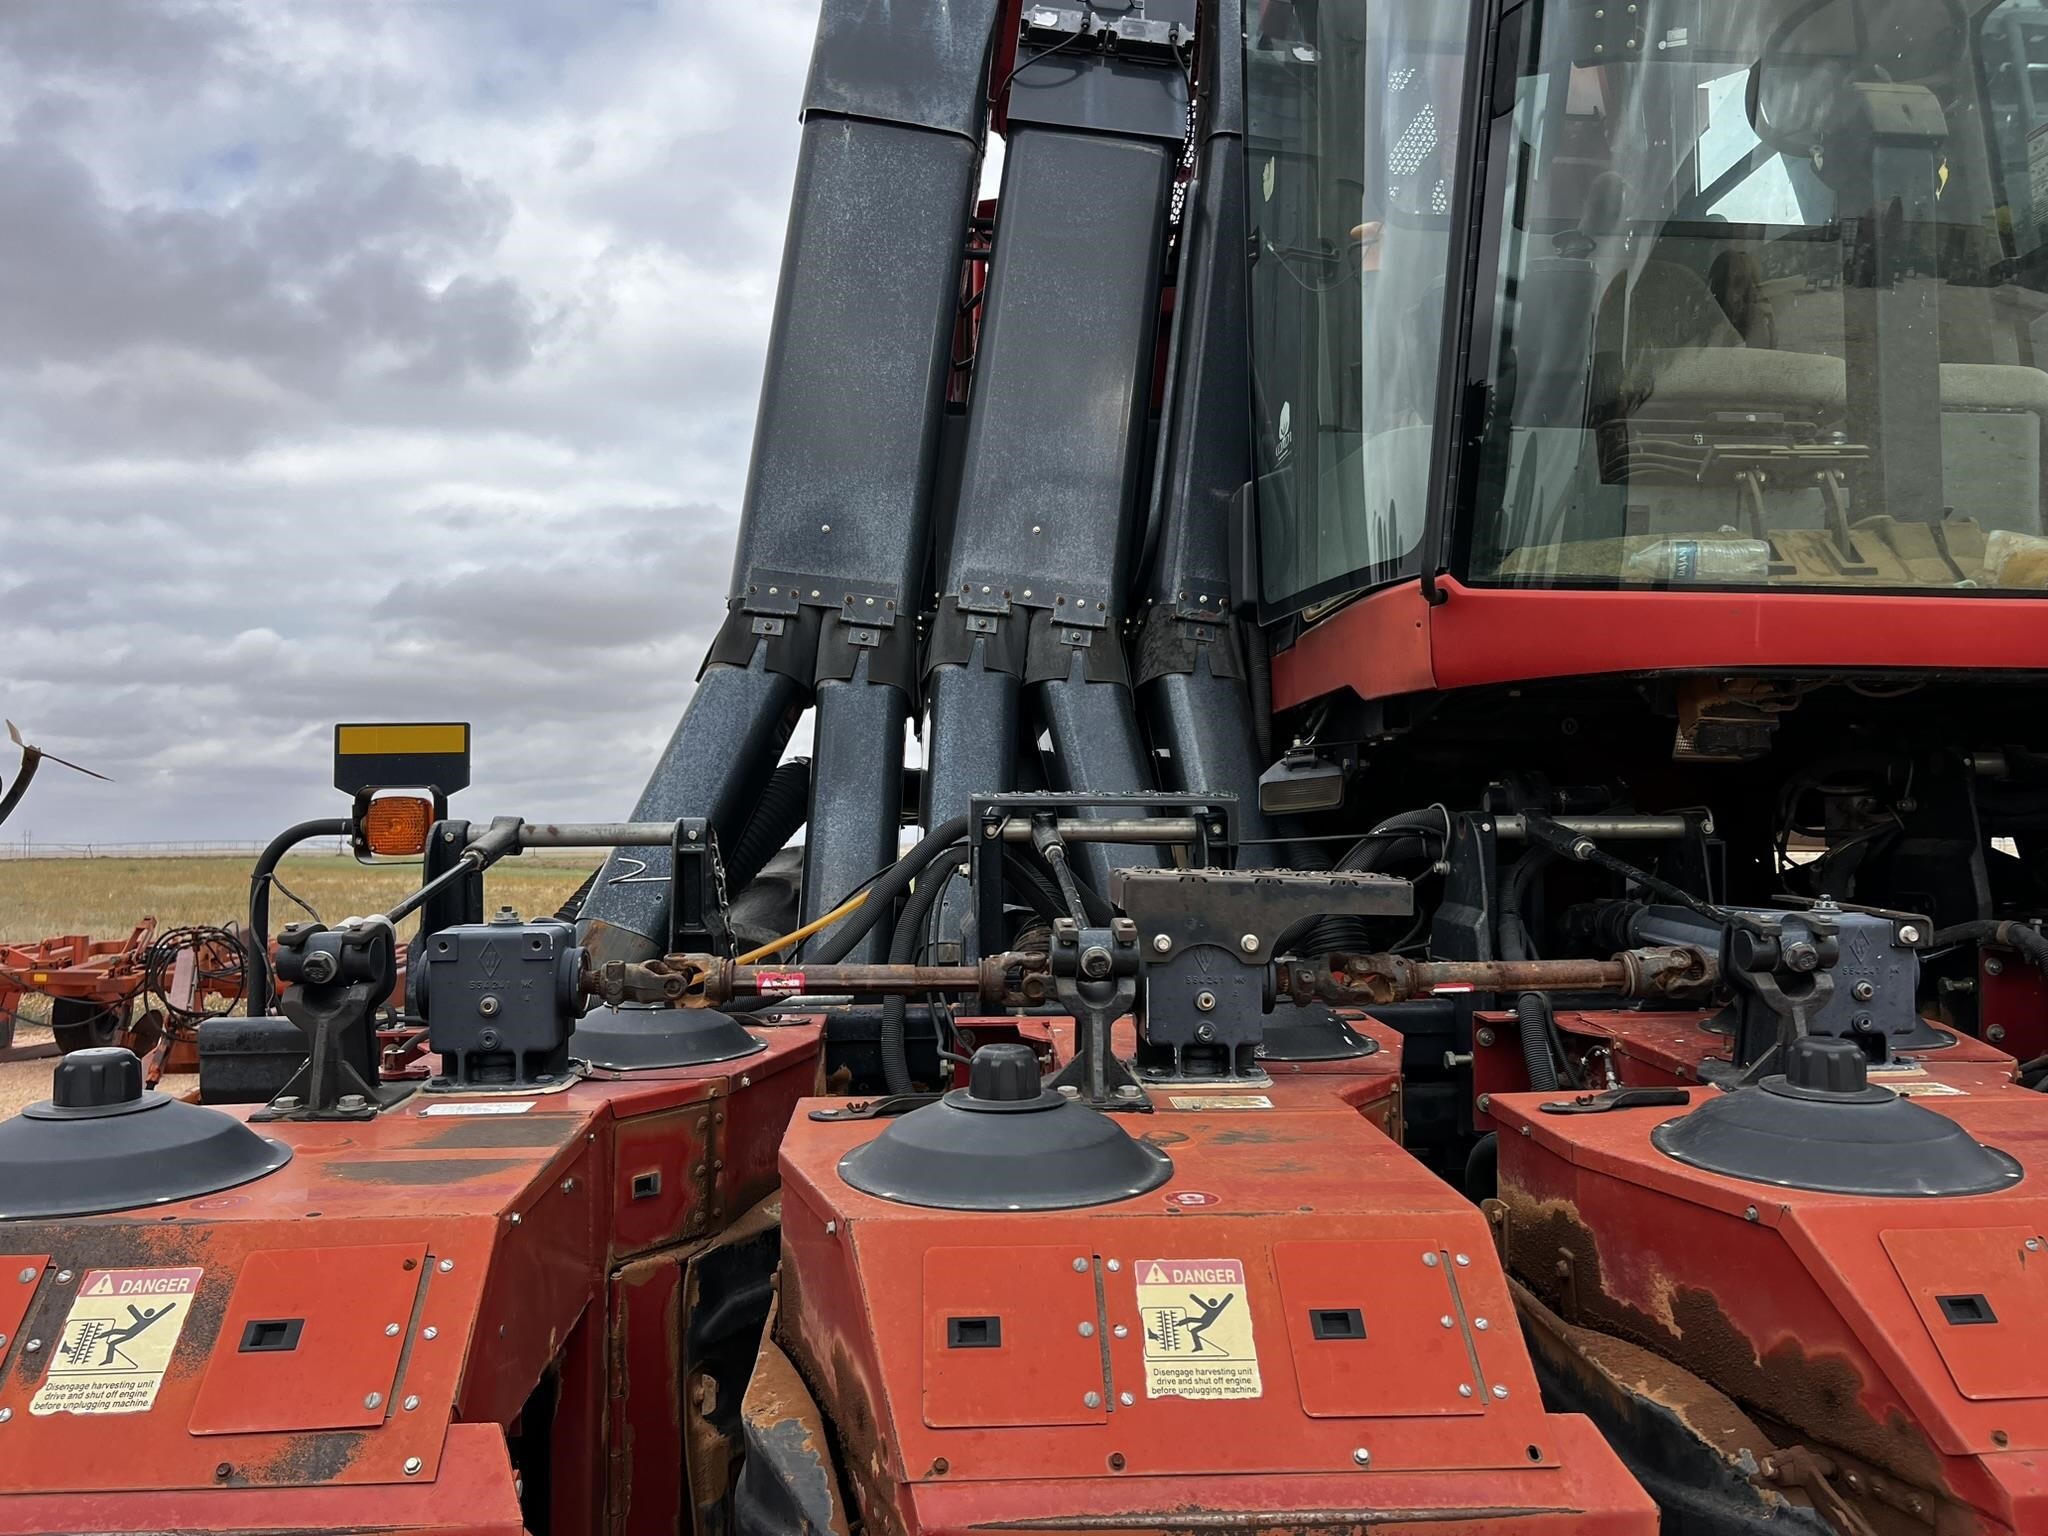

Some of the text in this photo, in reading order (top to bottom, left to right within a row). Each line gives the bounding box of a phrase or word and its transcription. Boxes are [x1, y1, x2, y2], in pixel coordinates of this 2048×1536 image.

[1677, 547, 1689, 575] DASANI
[1172, 1269, 1236, 1283] DANGER
[119, 1277, 191, 1295] DANGER
[1153, 1368, 1194, 1377] Disengage
[1195, 1368, 1236, 1377] harvesting
[45, 1380, 154, 1392] Disengage harvesting unit
[1157, 1377, 1252, 1386] drive and shut off engine
[44, 1390, 148, 1400] drive and shut off engine
[1152, 1386, 1259, 1395] before unplugging machine.
[34, 1399, 150, 1411] before unplugging machine.
